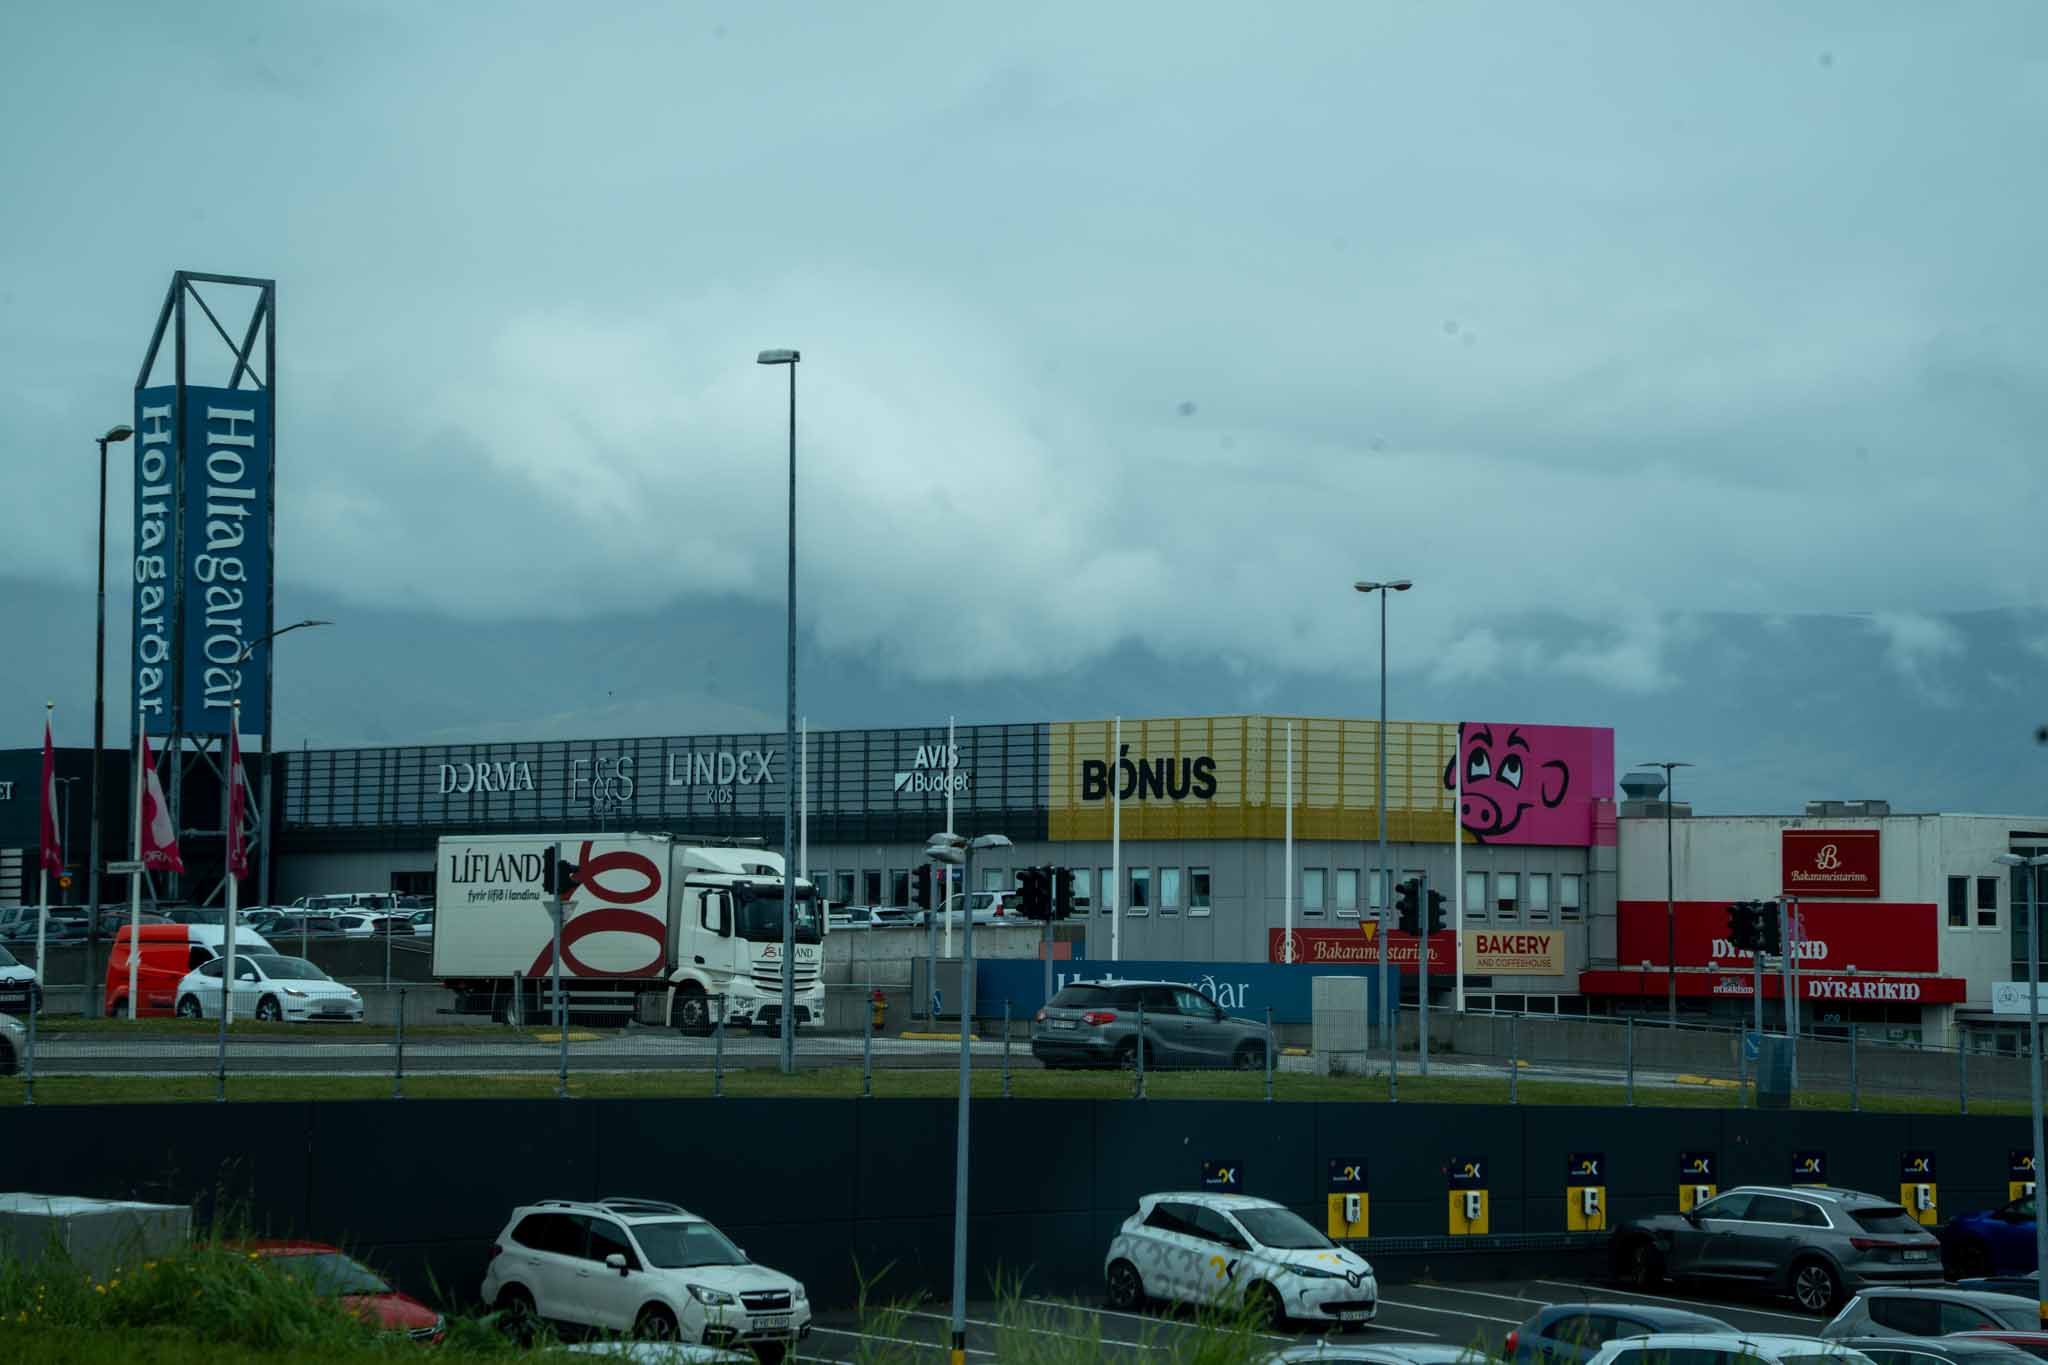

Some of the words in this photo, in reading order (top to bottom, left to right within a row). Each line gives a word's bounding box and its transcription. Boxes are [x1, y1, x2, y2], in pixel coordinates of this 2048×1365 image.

[134, 404, 173, 715] Holtagarðar
[194, 405, 256, 709] Holtagarðar
[668, 750, 777, 786] LINDEX
[914, 745, 960, 769] AVIS
[1082, 744, 1217, 800] BÓNUS
[707, 789, 733, 804] KIDS
[451, 848, 541, 883] LÍFLAND
[1476, 935, 1551, 954] BAKERY
[1477, 959, 1494, 968] AND
[1496, 958, 1552, 968] COFFEEHOUSE
[1808, 976, 1921, 1001] DÝRARÍKIÐ
